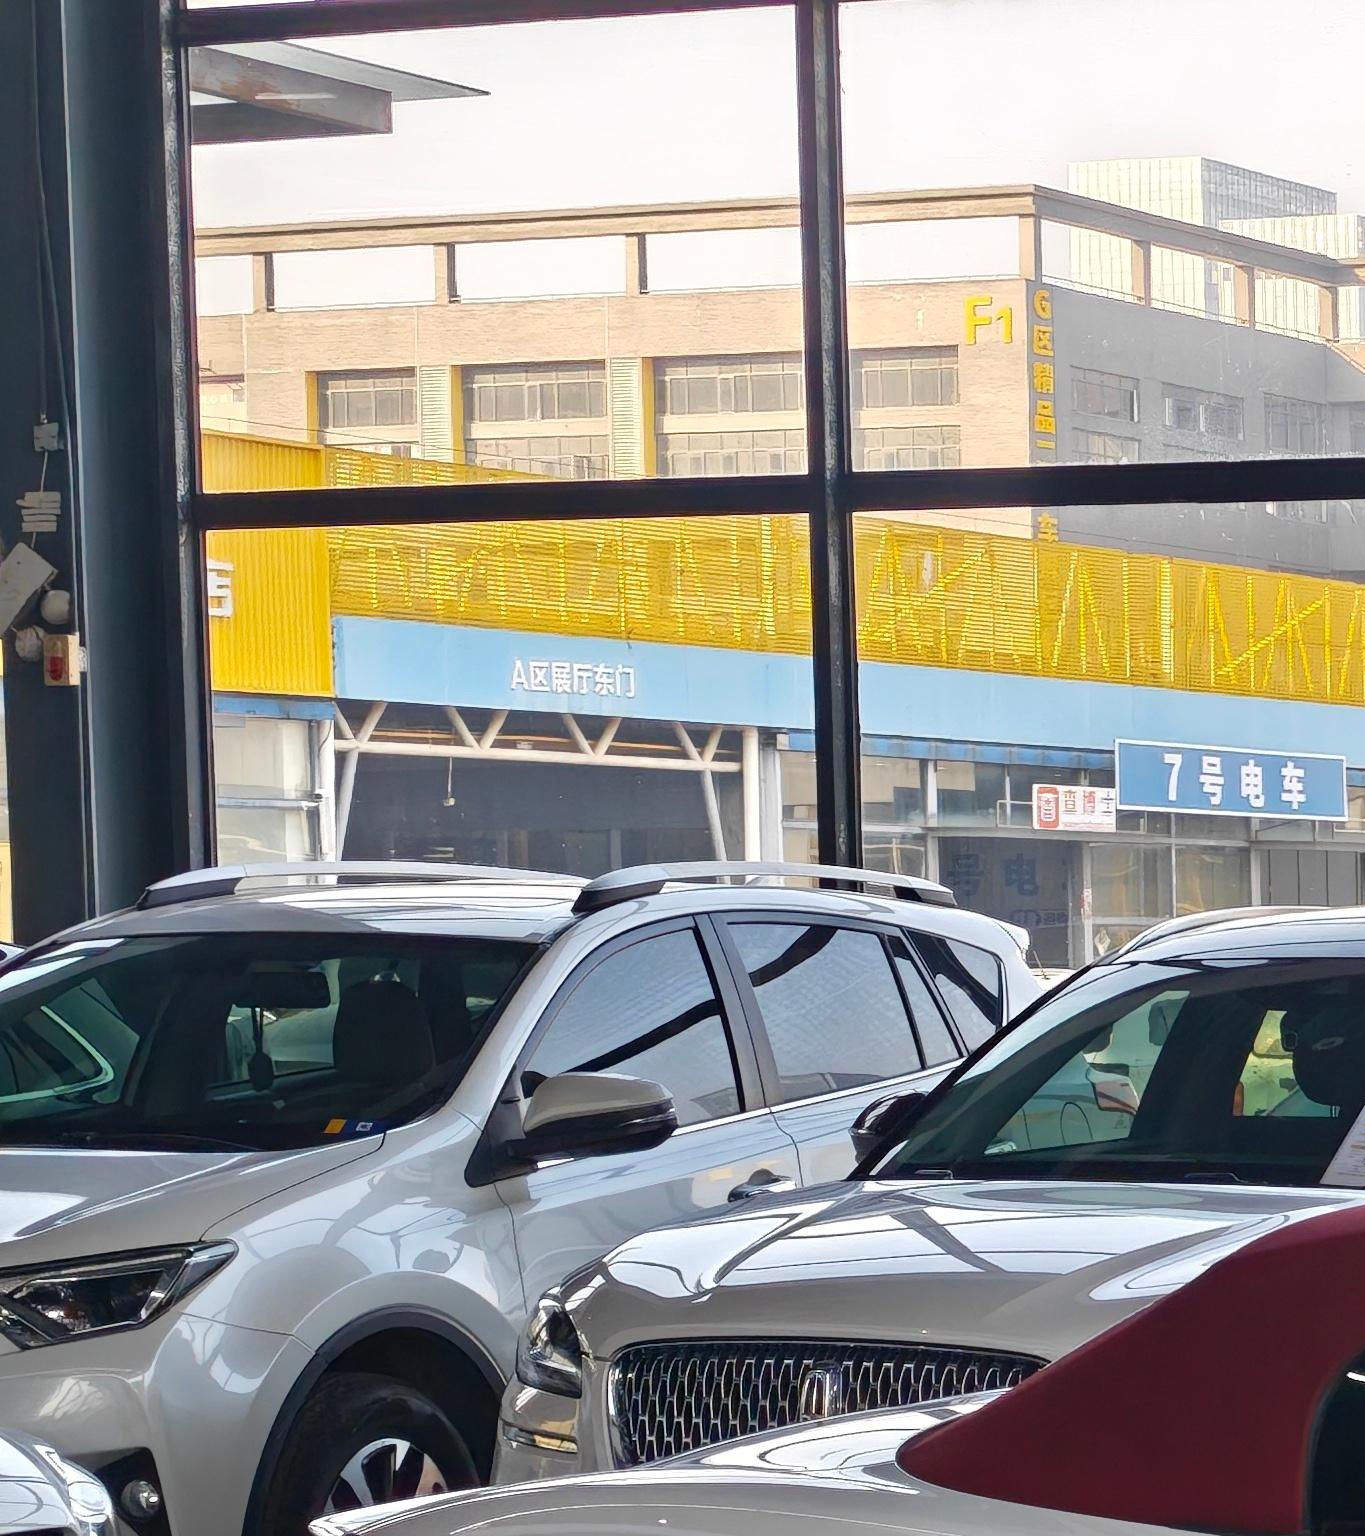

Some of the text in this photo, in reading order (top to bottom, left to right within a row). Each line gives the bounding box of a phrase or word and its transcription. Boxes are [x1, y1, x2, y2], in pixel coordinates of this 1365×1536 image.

[964, 296, 1012, 345] F1
[511, 656, 635, 699] A区展厅东门
[1163, 753, 1306, 811] 7号电车
